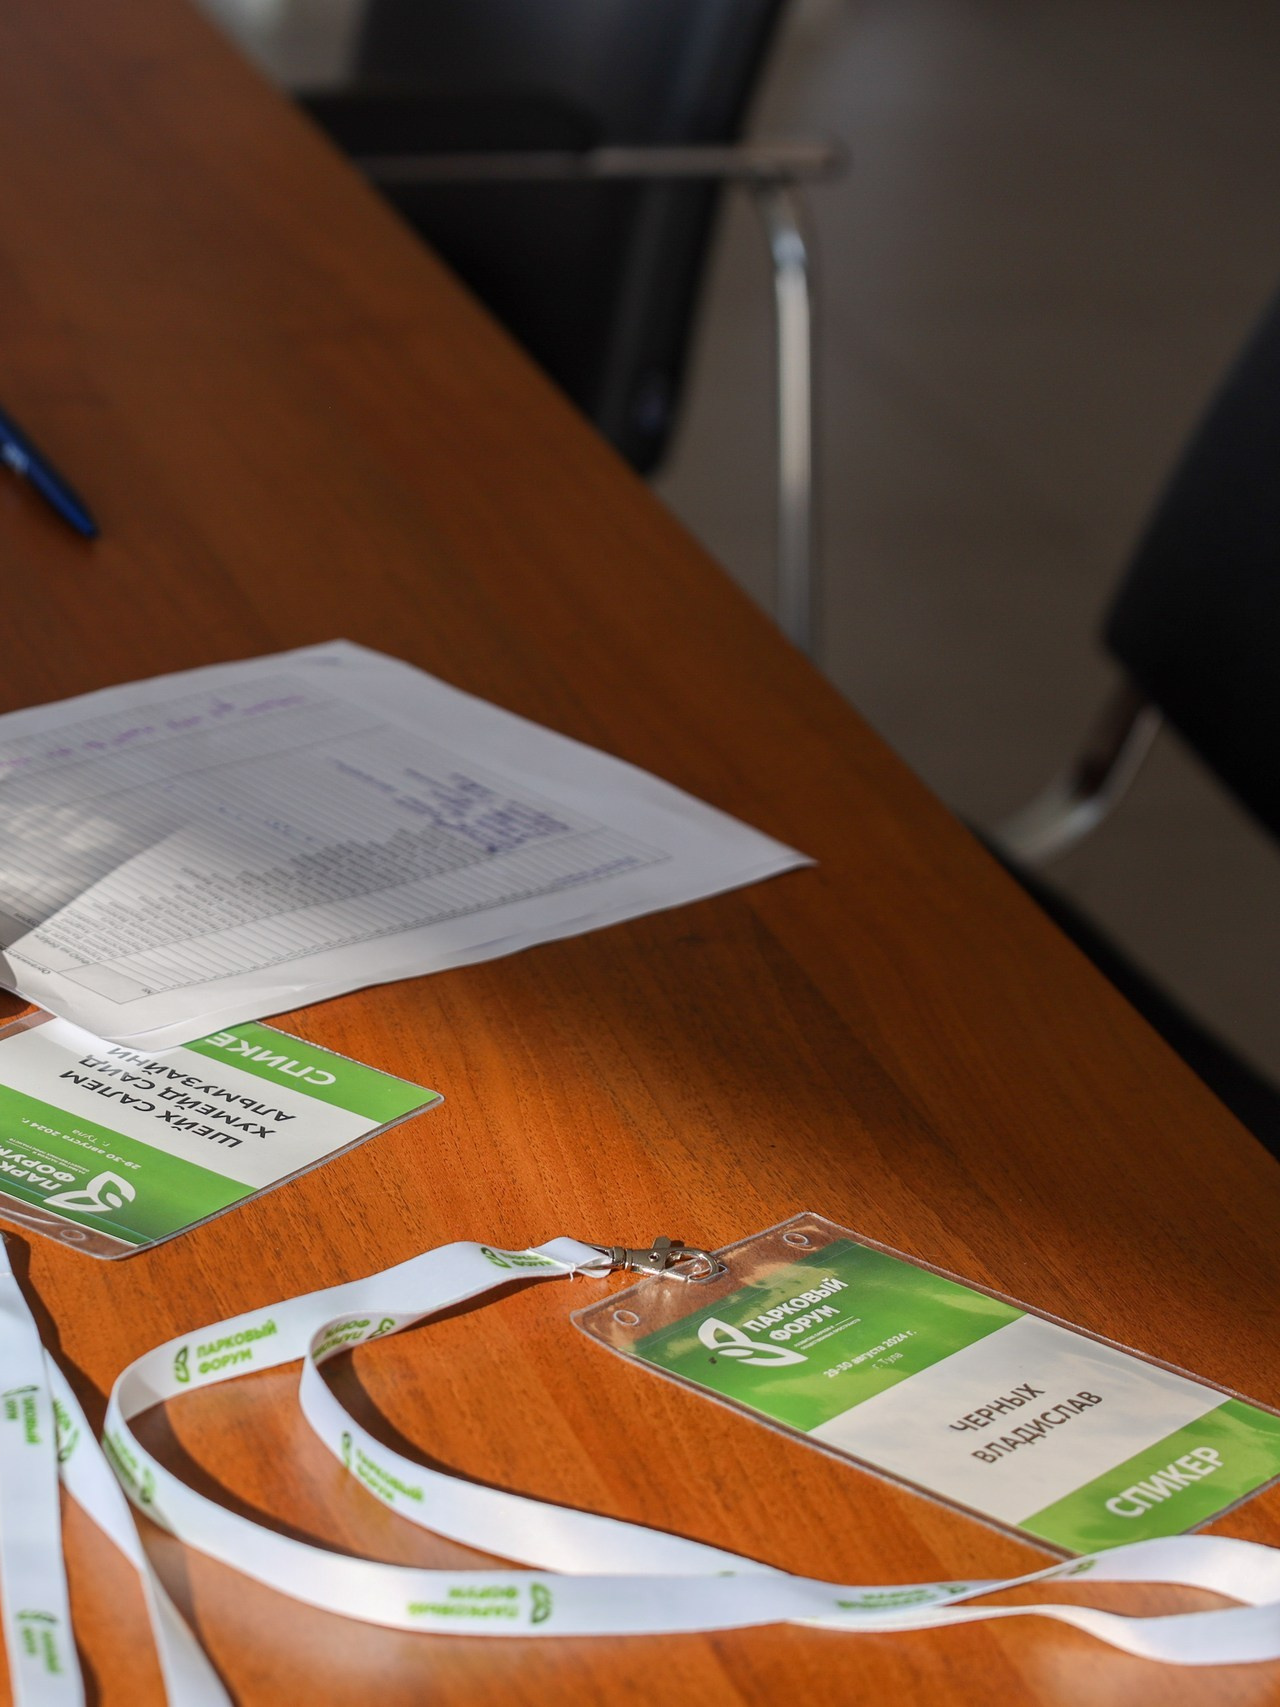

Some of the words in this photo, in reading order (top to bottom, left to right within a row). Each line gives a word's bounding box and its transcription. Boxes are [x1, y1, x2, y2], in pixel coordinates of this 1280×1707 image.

[78, 1054, 156, 1090] САИД
[204, 1032, 337, 1086] СПИКЕ
[59, 1070, 156, 1112] САЛЕМ
[106, 1047, 297, 1123] АЛЬМУЗАЙНИ
[29, 1122, 61, 1137] 2024
[156, 1110, 243, 1148] ШЕЙХ
[157, 1087, 276, 1139] ХУМЕЙД
[62, 1134, 106, 1154] августа
[71, 1129, 98, 1143] Тула
[106, 1153, 142, 1170] 29-30
[742, 1277, 849, 1333] ПАРКОВЫЙ
[769, 1304, 841, 1342] ФОРУМ
[197, 1319, 278, 1358] ПАРКОВЫЙ
[823, 1360, 854, 1379] 29-30
[851, 1342, 886, 1366] августа
[881, 1333, 908, 1349] 2024
[198, 1348, 253, 1374] ФОРУМ
[879, 1351, 903, 1367] Тула
[948, 1382, 1046, 1433] ЧЕРНЫХ
[971, 1391, 1103, 1464] ВЛАДИСЛАВ
[1105, 1446, 1224, 1518] СПИКЕР
